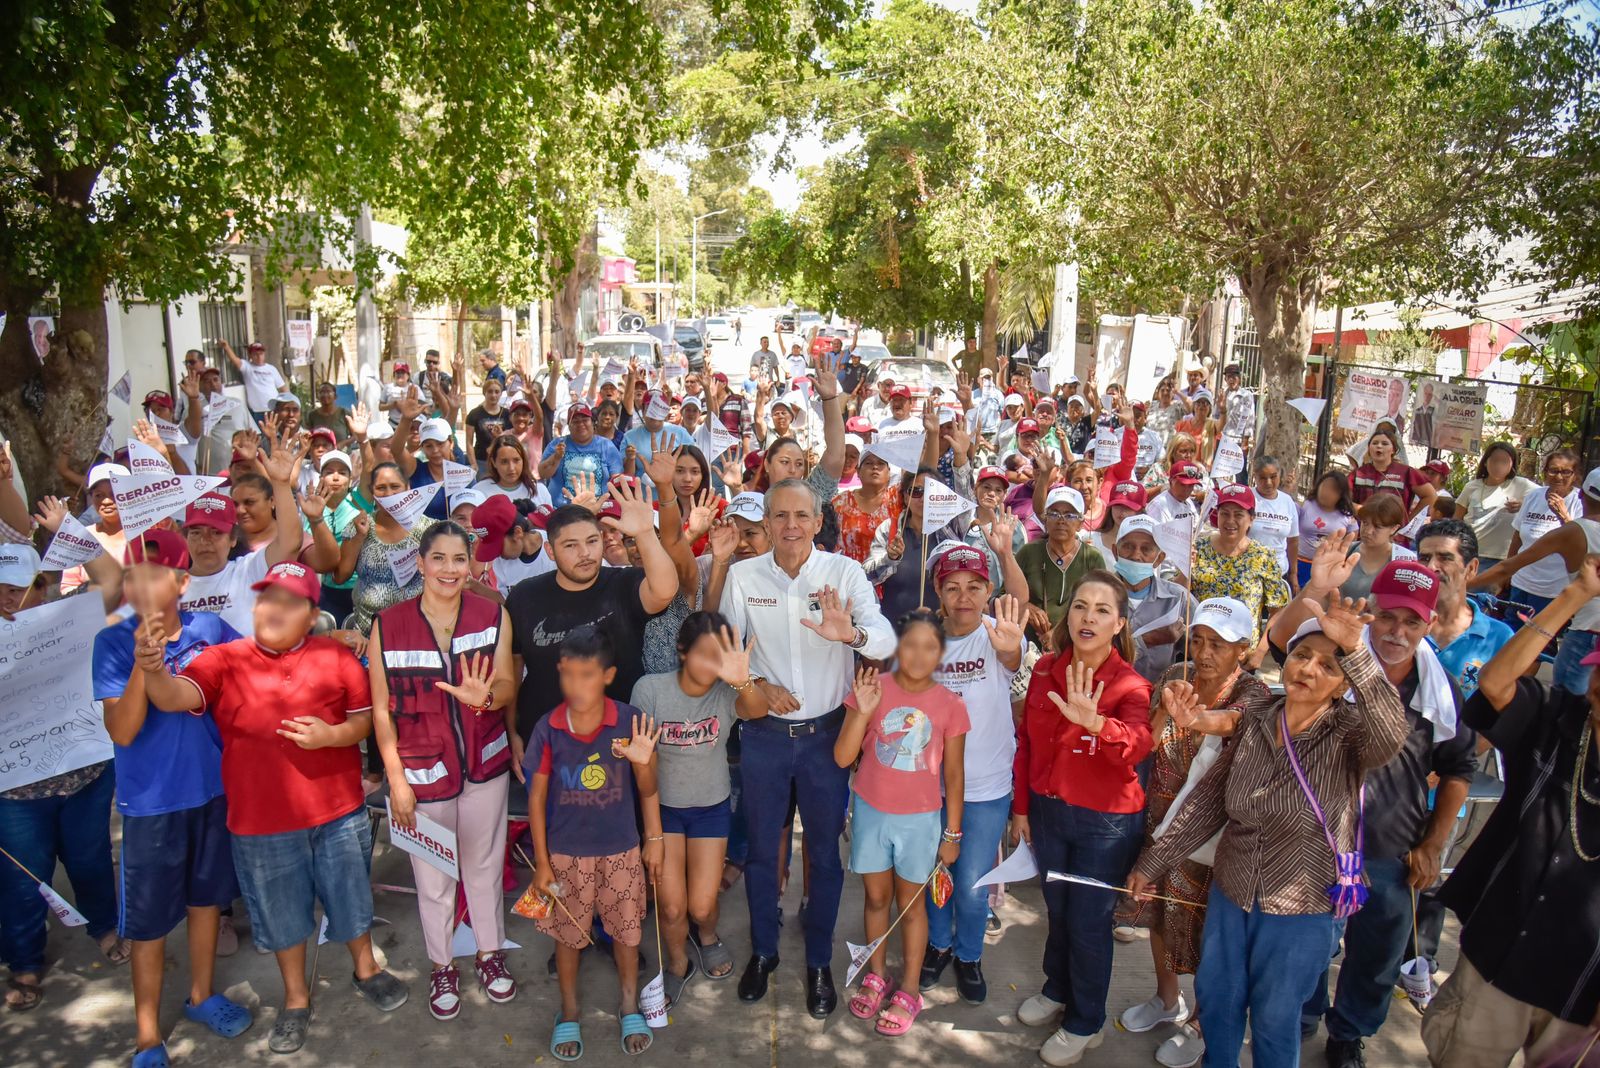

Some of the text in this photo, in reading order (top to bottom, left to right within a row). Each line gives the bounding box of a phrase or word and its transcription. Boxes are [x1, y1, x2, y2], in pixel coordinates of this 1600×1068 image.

[1351, 374, 1387, 389] GERARDO
[116, 477, 181, 502] GERARDO
[118, 486, 184, 508] VARGAS LANDEROS
[929, 494, 958, 502] GERARDO
[123, 517, 153, 530] morena
[1254, 511, 1289, 521] ERARDO
[1527, 512, 1558, 522] GERARD
[57, 531, 100, 550] GERARDO
[393, 547, 420, 566] GERARD
[1395, 568, 1433, 585] GERARDO
[179, 594, 229, 610] ERARD
[747, 596, 777, 605] morena
[935, 657, 985, 673] RARDO
[946, 668, 986, 680] LANDEROS
[951, 677, 980, 686] MUNICIPAL
[667, 728, 701, 739] Hurley
[20, 750, 31, 768] 5
[391, 818, 455, 861] morena
